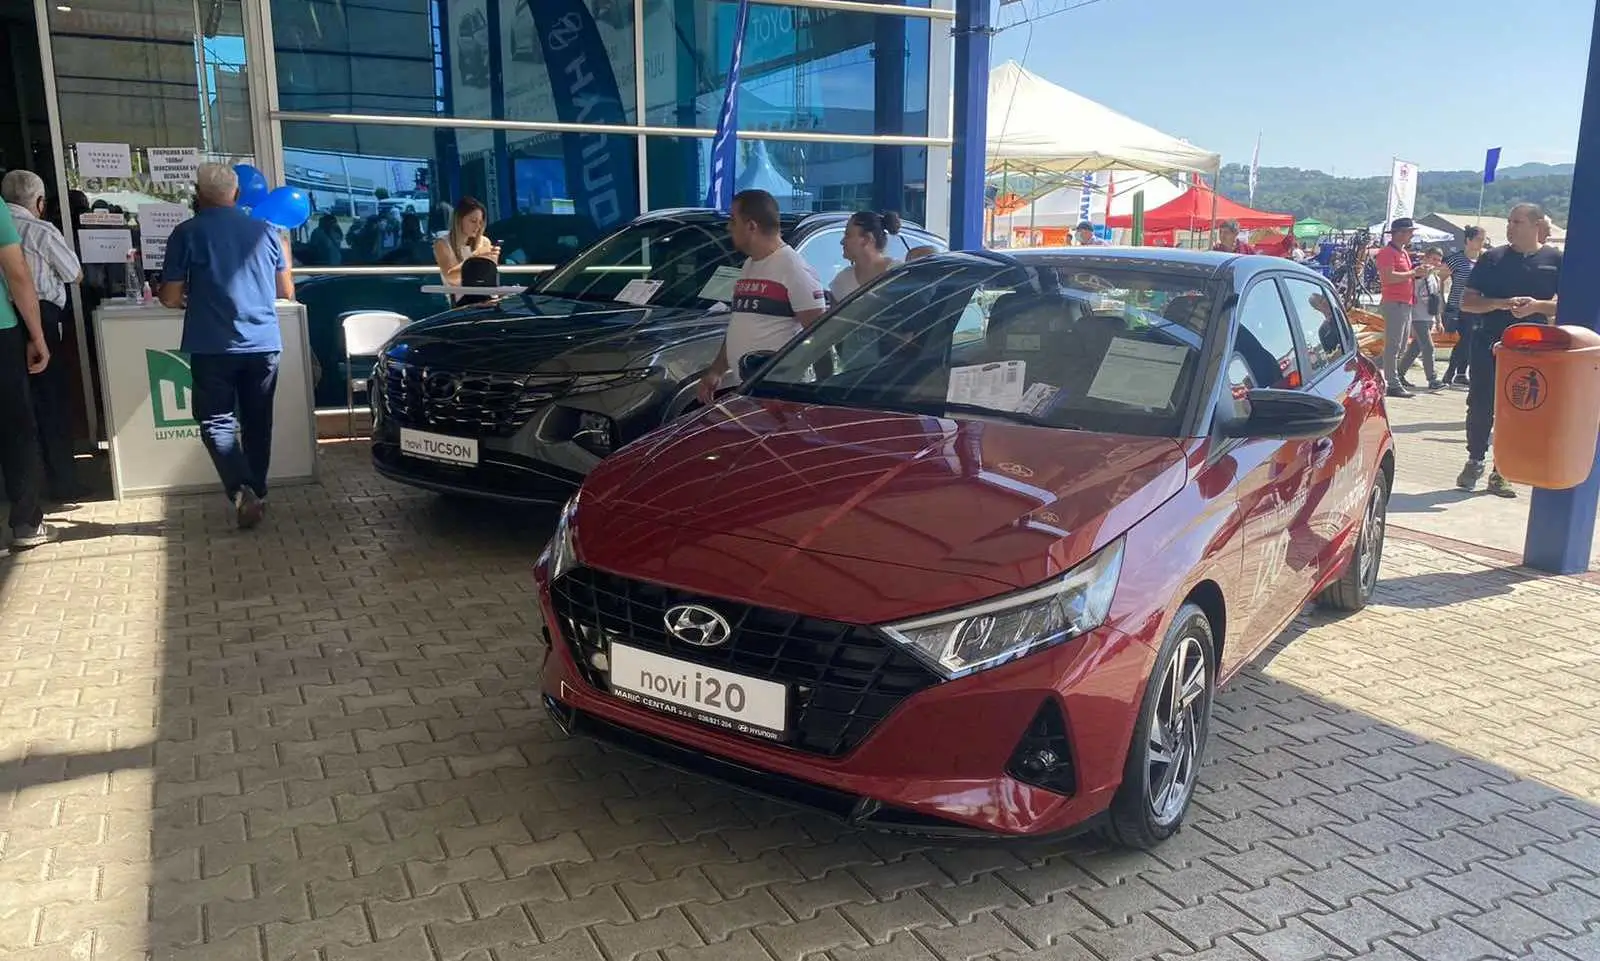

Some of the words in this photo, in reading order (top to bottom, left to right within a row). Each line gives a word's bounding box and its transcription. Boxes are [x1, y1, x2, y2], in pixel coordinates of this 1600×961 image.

[424, 439, 471, 459] TUCSON
[640, 669, 686, 699] novi
[695, 672, 746, 713] i20
[642, 697, 677, 714] CENTAR
